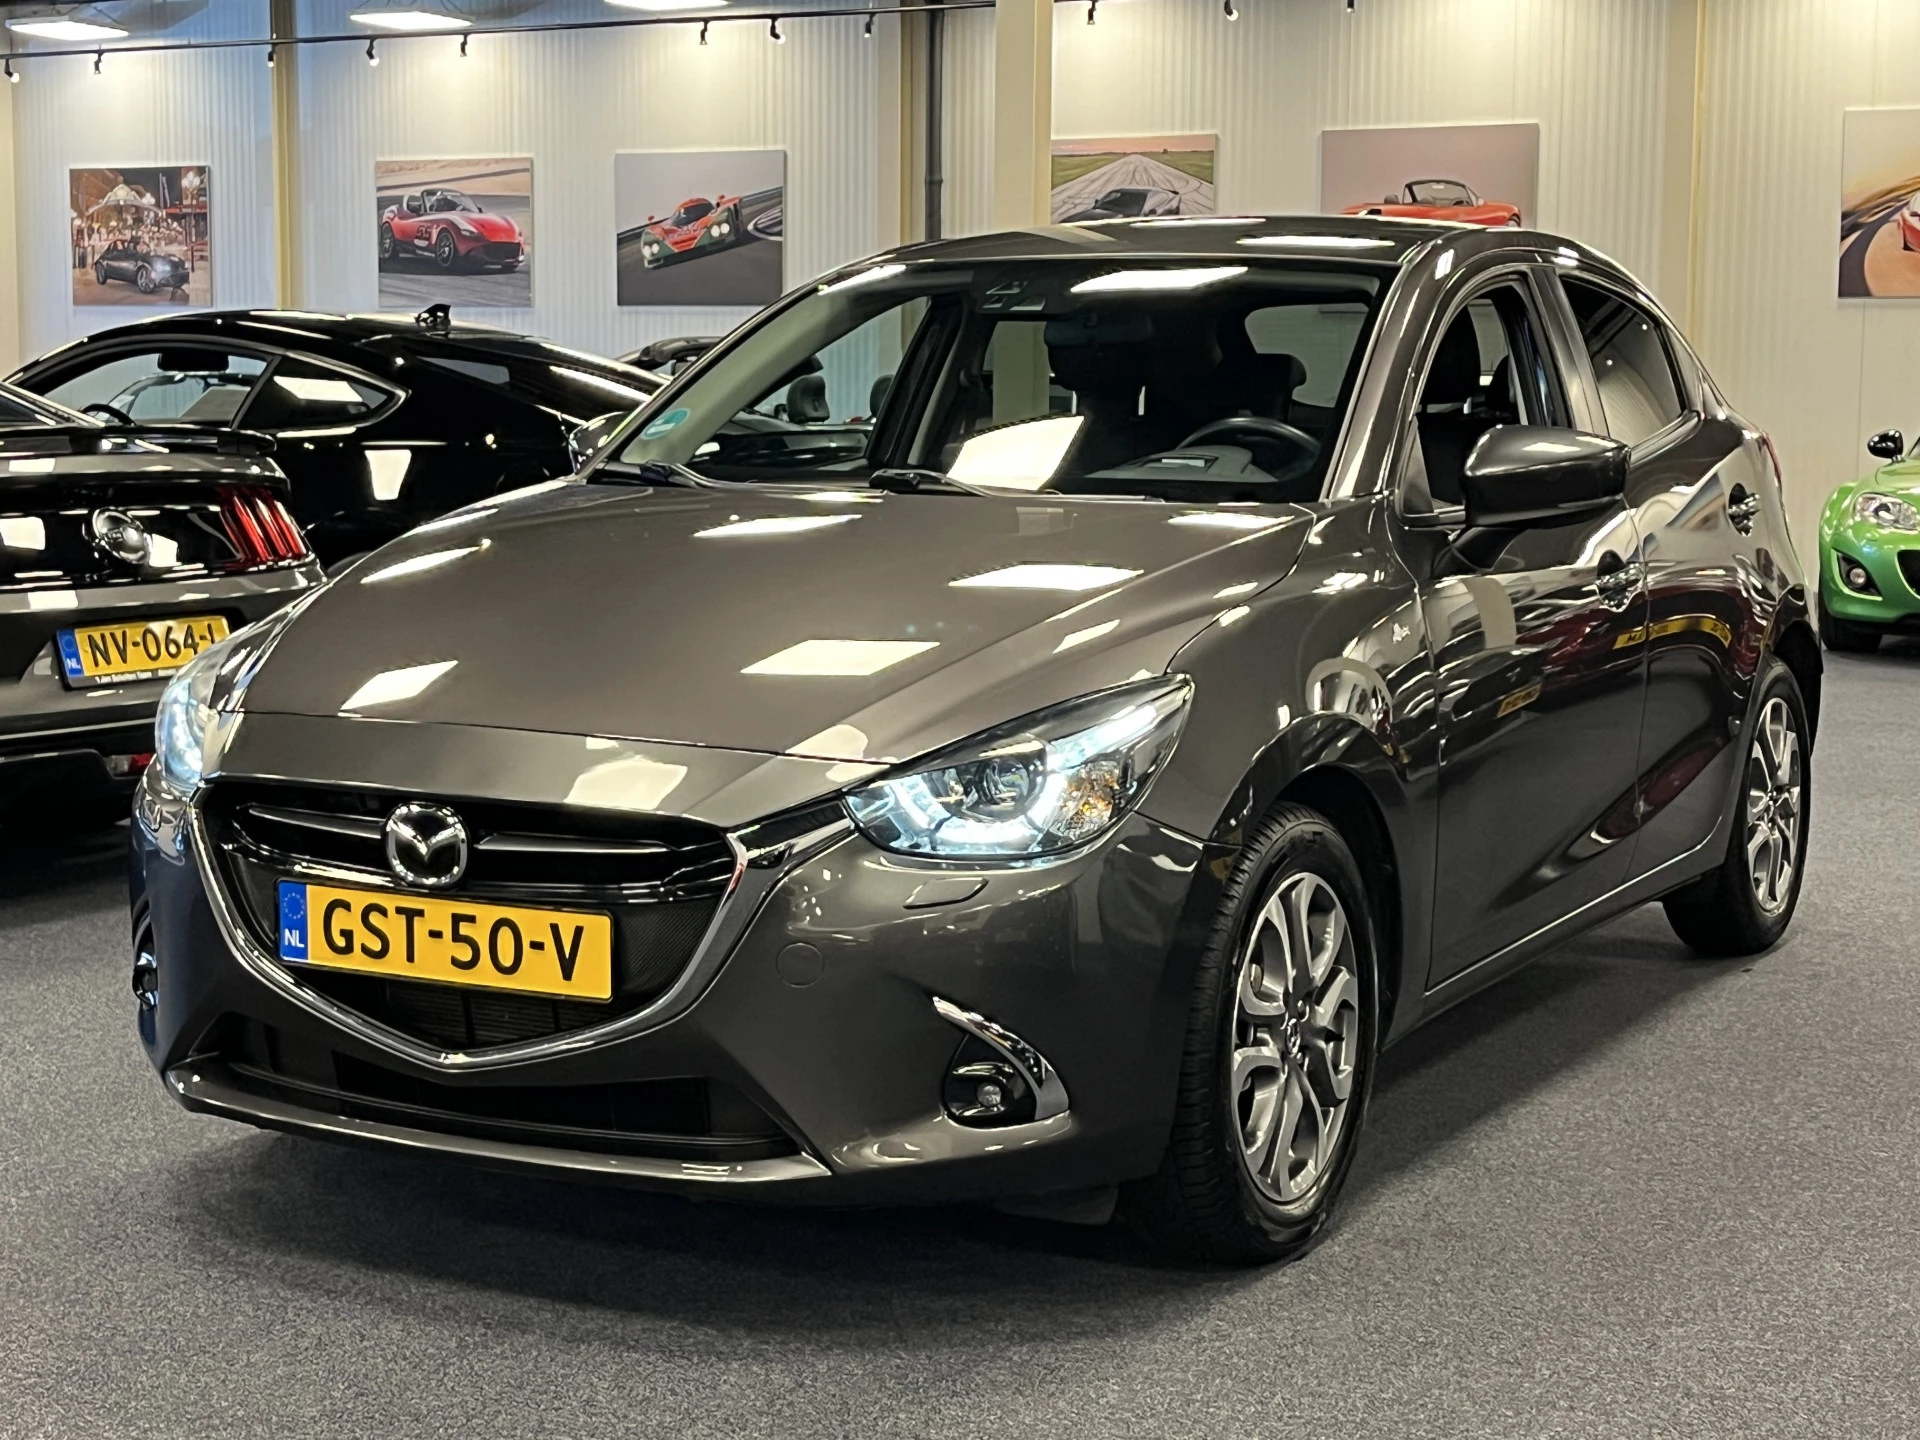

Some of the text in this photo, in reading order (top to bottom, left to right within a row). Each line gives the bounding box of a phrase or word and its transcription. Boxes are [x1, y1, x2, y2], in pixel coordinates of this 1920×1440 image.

[66, 657, 81, 670] NL
[284, 928, 305, 948] NL
[322, 898, 584, 982] GST-50-V
